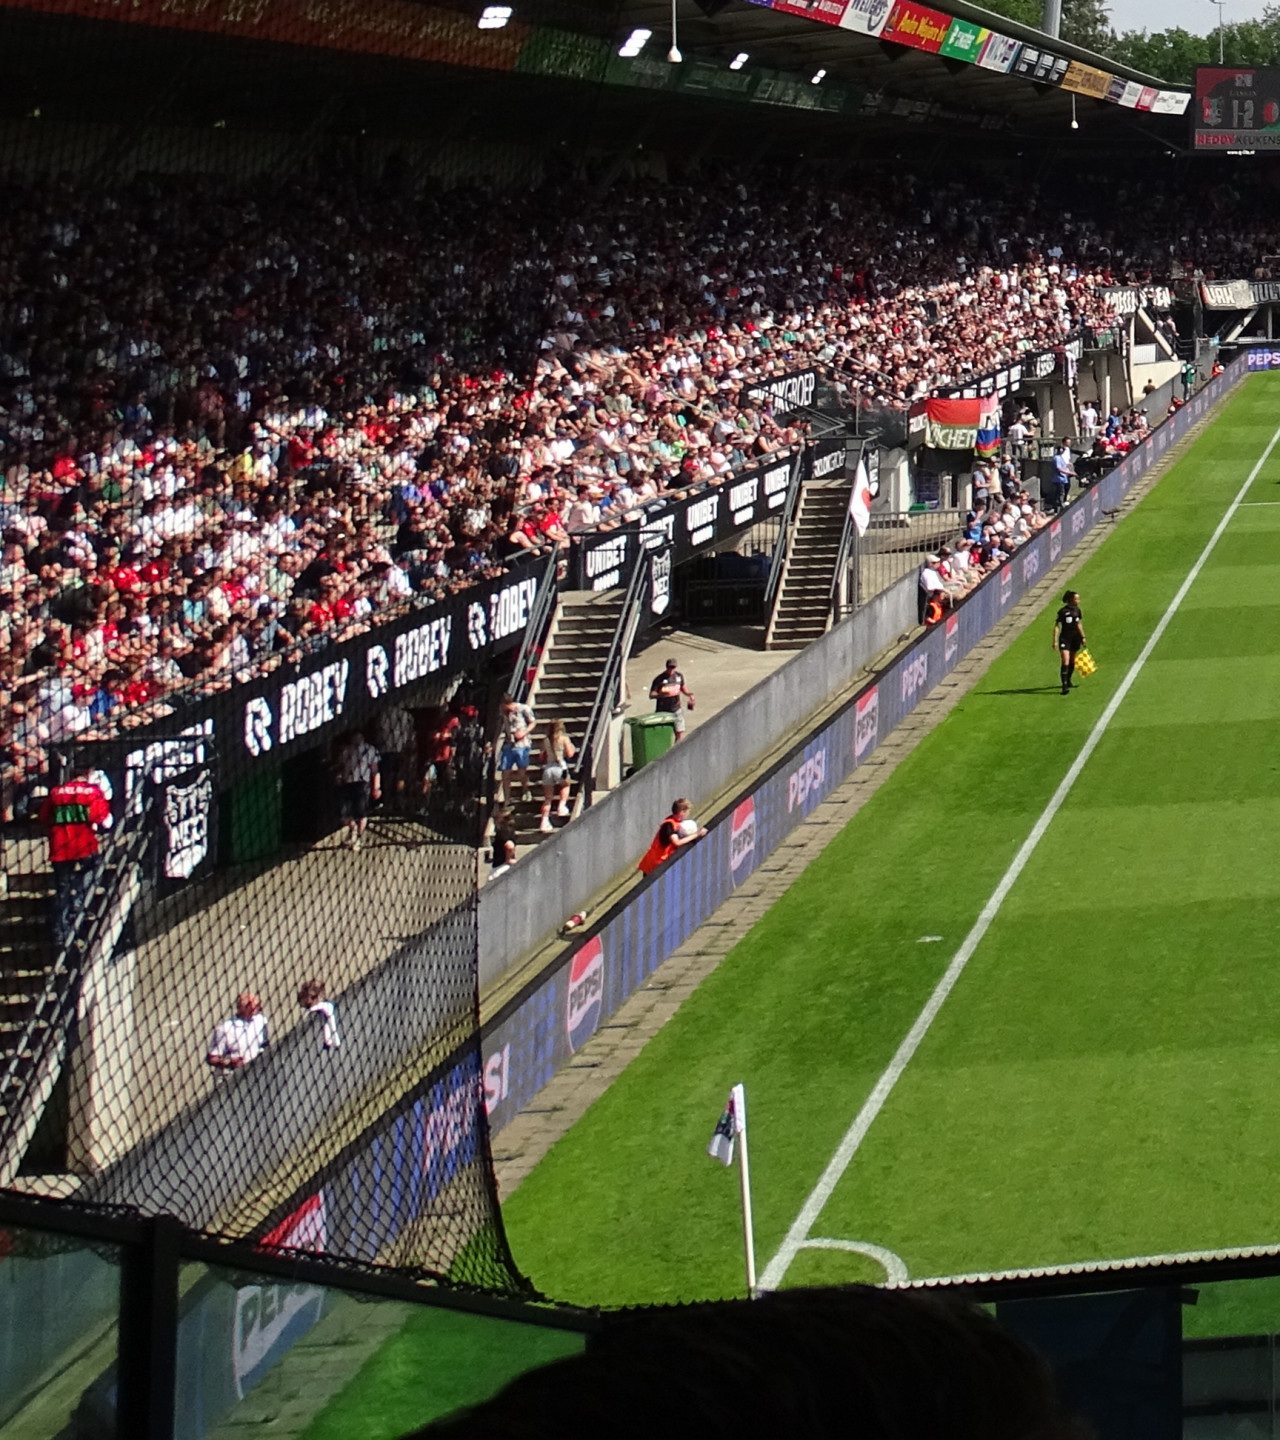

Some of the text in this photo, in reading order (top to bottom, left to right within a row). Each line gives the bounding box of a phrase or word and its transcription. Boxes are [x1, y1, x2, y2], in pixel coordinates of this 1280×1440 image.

[1197, 133, 1235, 145] REDDY
[729, 477, 759, 511] UNIBET
[764, 463, 791, 496] UNIBET
[687, 495, 719, 532] UNIBET
[587, 534, 627, 578] UNIBET
[490, 577, 537, 641] ROBEY
[394, 615, 452, 688] ROBEY
[902, 652, 928, 702] PEPSI
[280, 658, 348, 744] ROBEY
[788, 747, 825, 813] PEPSI
[732, 823, 755, 859] PEPSI
[569, 973, 600, 1011] PEPSI
